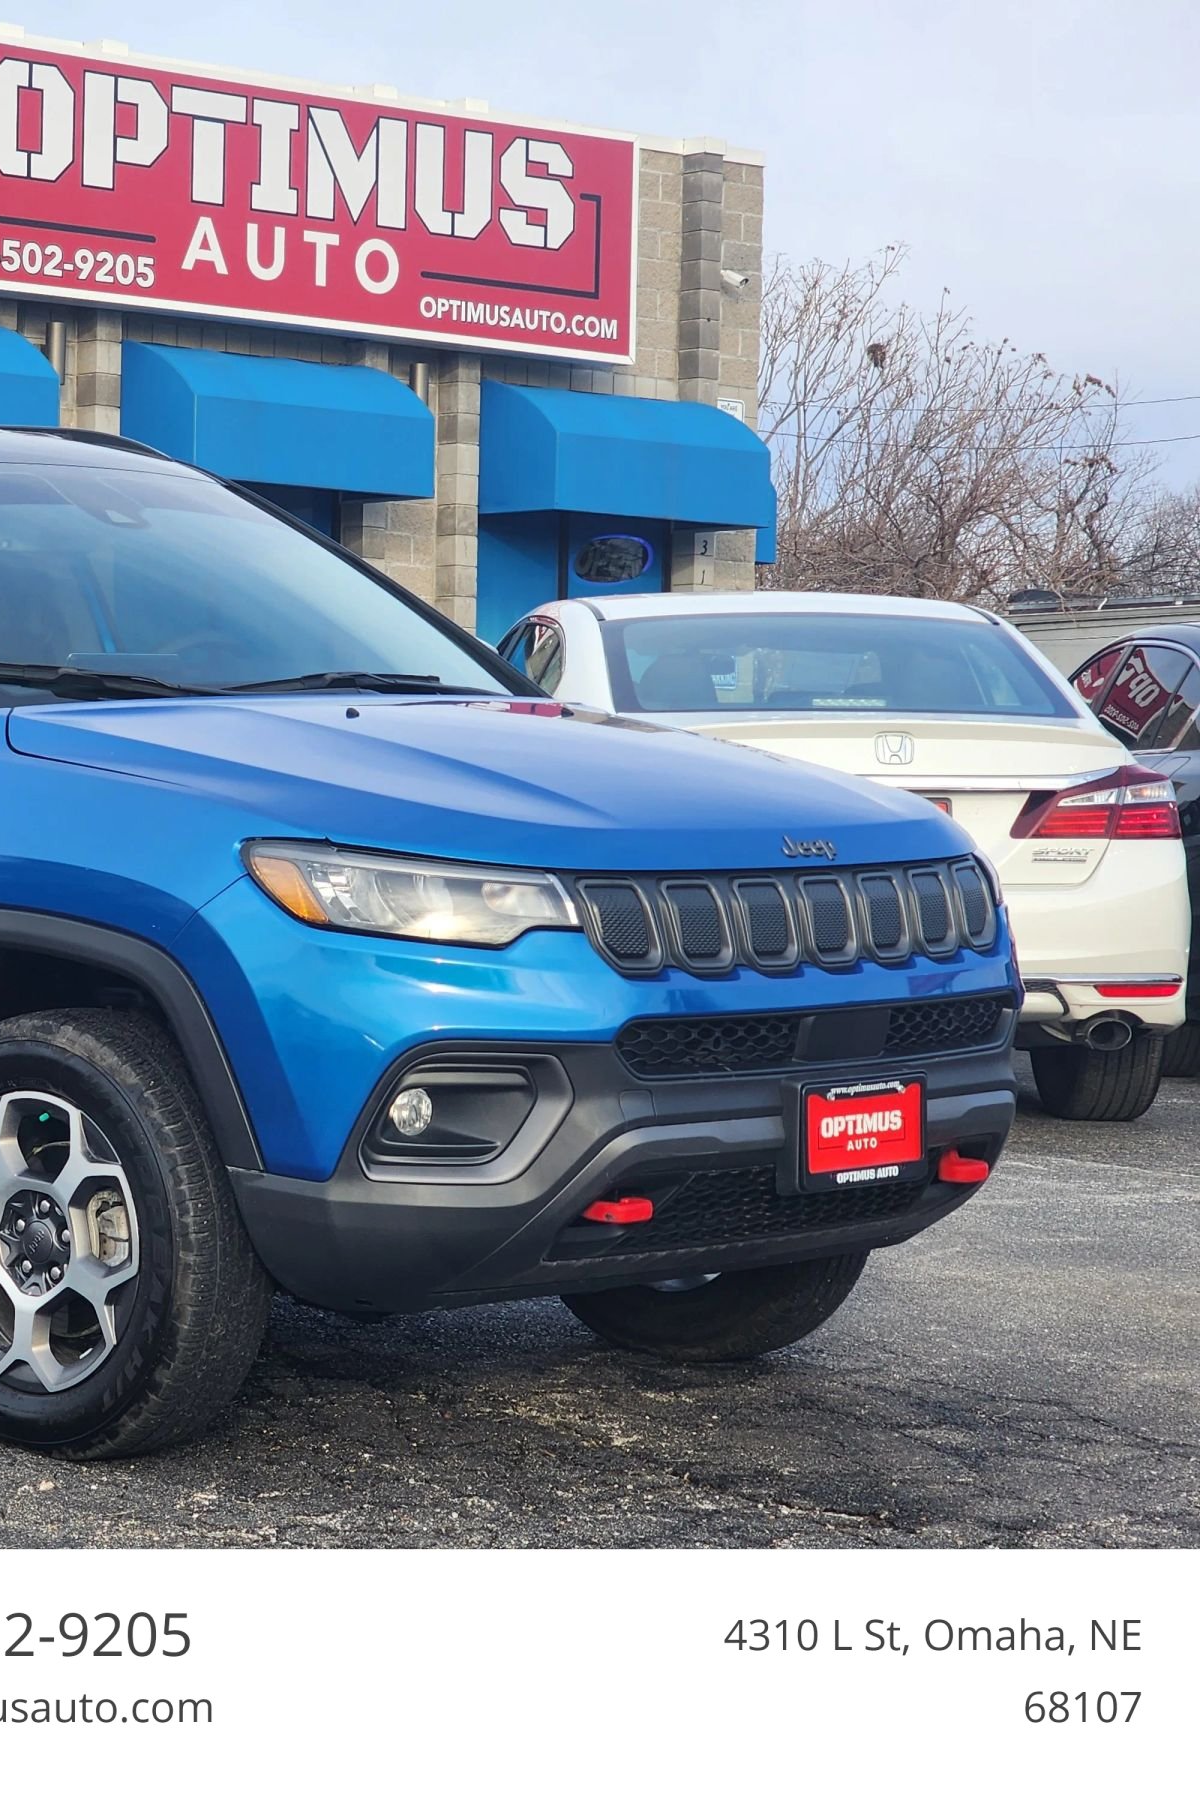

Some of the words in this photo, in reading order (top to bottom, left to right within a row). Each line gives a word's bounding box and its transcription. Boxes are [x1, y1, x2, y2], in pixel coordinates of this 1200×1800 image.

[181, 217, 400, 294] AUTO
[420, 296, 618, 341] OPTIMUSAUTO.COM
[781, 835, 836, 861] Jeep
[820, 1109, 902, 1139] OPTIMUS
[847, 1139, 878, 1151] AUTO
[836, 1168, 876, 1184] OPTIMUS
[876, 1165, 899, 1180] AUTO
